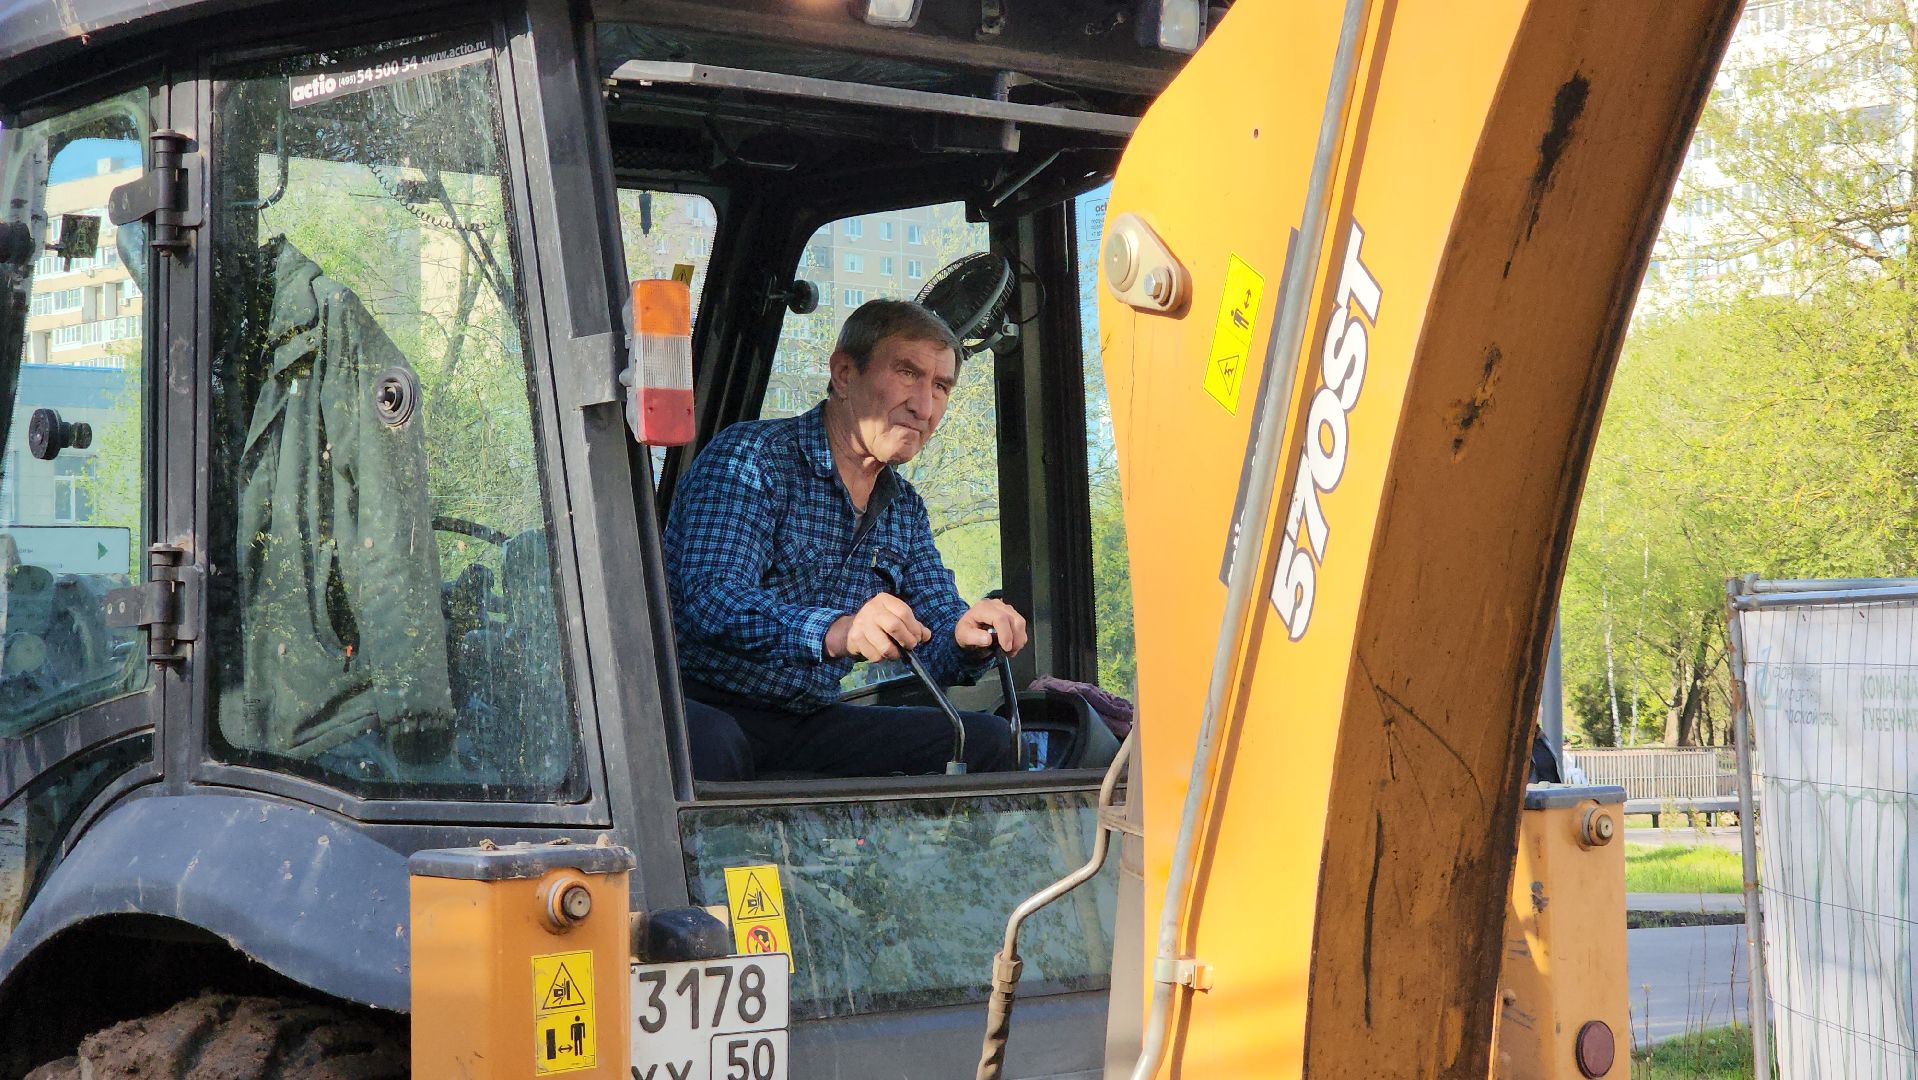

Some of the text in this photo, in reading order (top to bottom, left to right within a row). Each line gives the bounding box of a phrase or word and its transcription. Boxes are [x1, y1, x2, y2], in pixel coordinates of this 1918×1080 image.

[292, 40, 487, 102] actio (495) 54 500 54 www.actio.ru
[1270, 215, 1383, 643] 570ST
[639, 964, 767, 1033] 3178
[728, 1038, 776, 1080] 50
